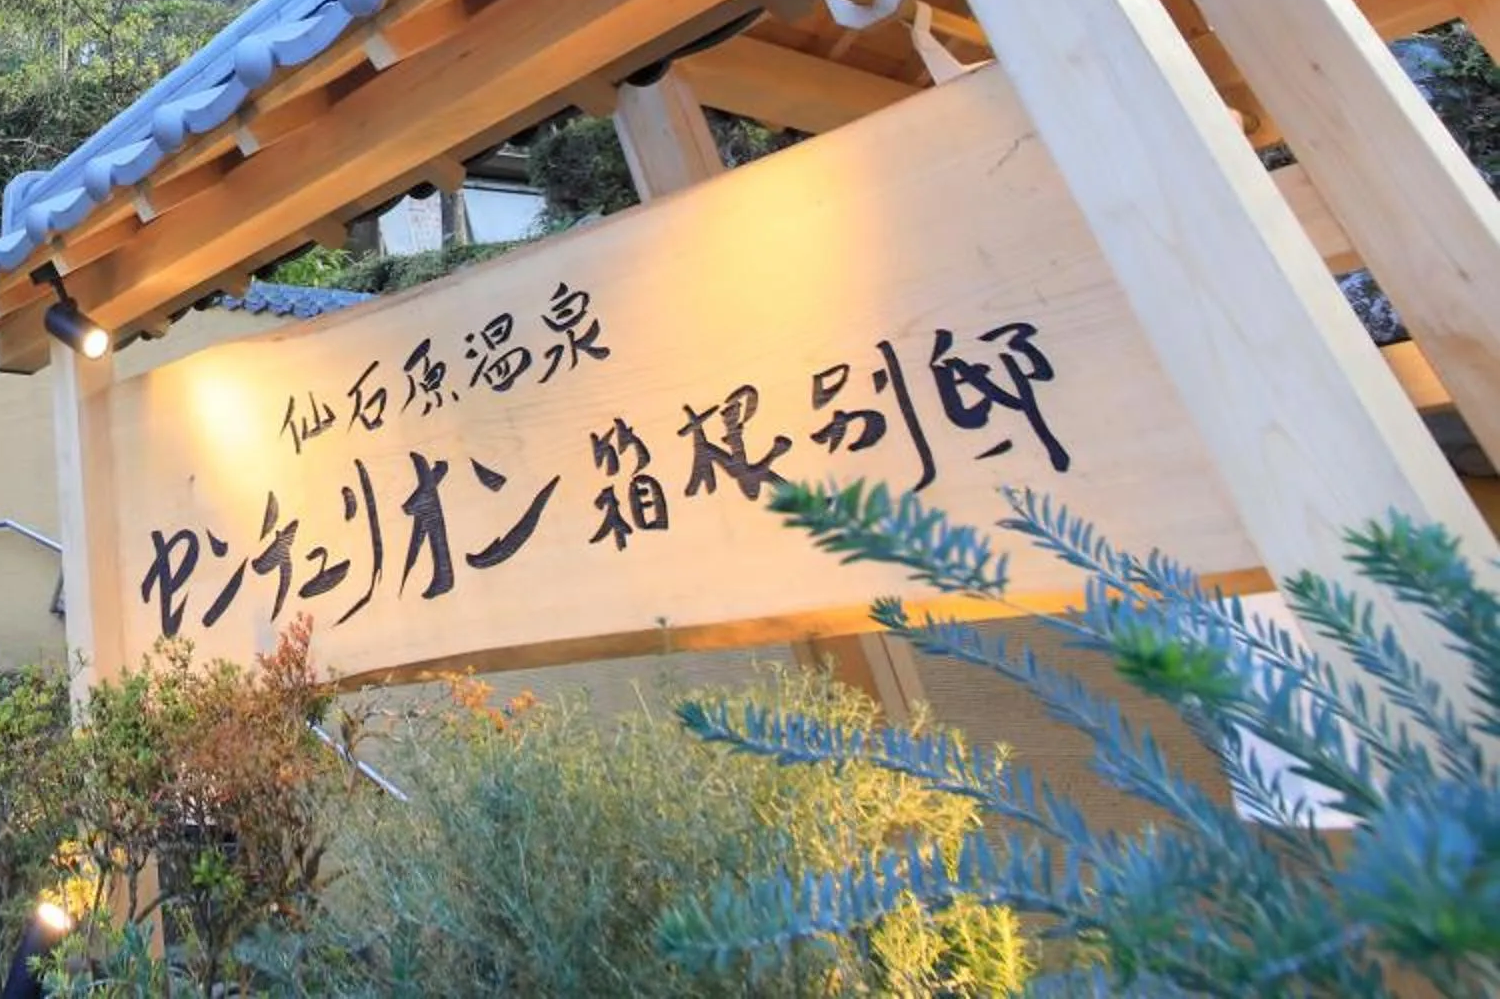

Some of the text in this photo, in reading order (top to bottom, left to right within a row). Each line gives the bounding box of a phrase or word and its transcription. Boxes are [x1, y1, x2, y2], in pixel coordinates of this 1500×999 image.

[280, 282, 611, 454] 仙石原温泉
